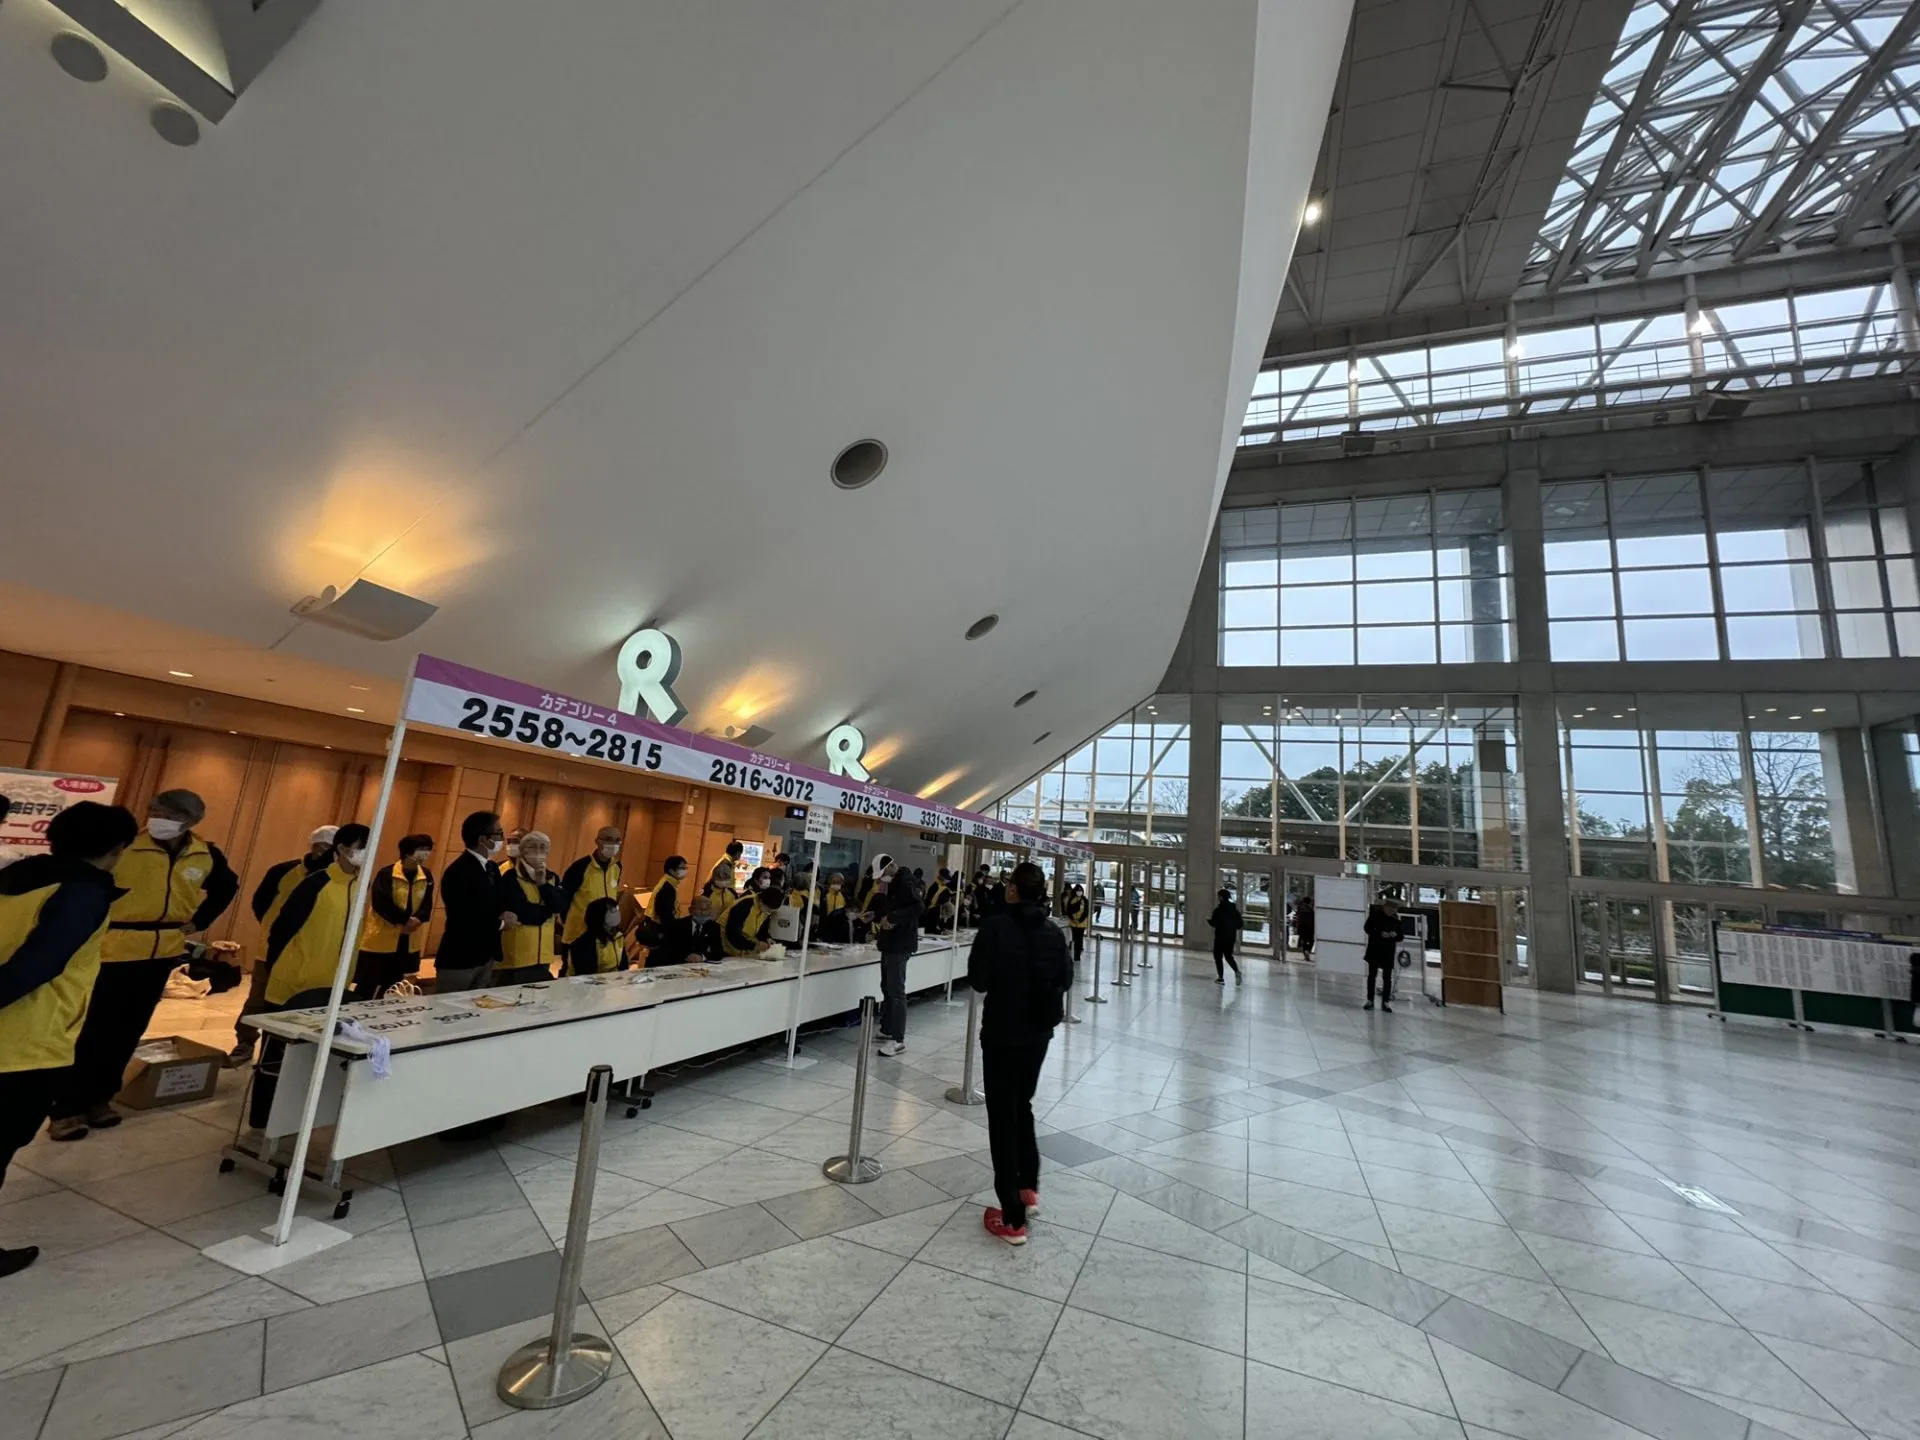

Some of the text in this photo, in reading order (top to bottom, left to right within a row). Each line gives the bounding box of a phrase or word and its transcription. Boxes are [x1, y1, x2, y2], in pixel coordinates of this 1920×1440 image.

[617, 629, 683, 725] R
[539, 693, 618, 726] カテゴリー4
[826, 725, 871, 782] R
